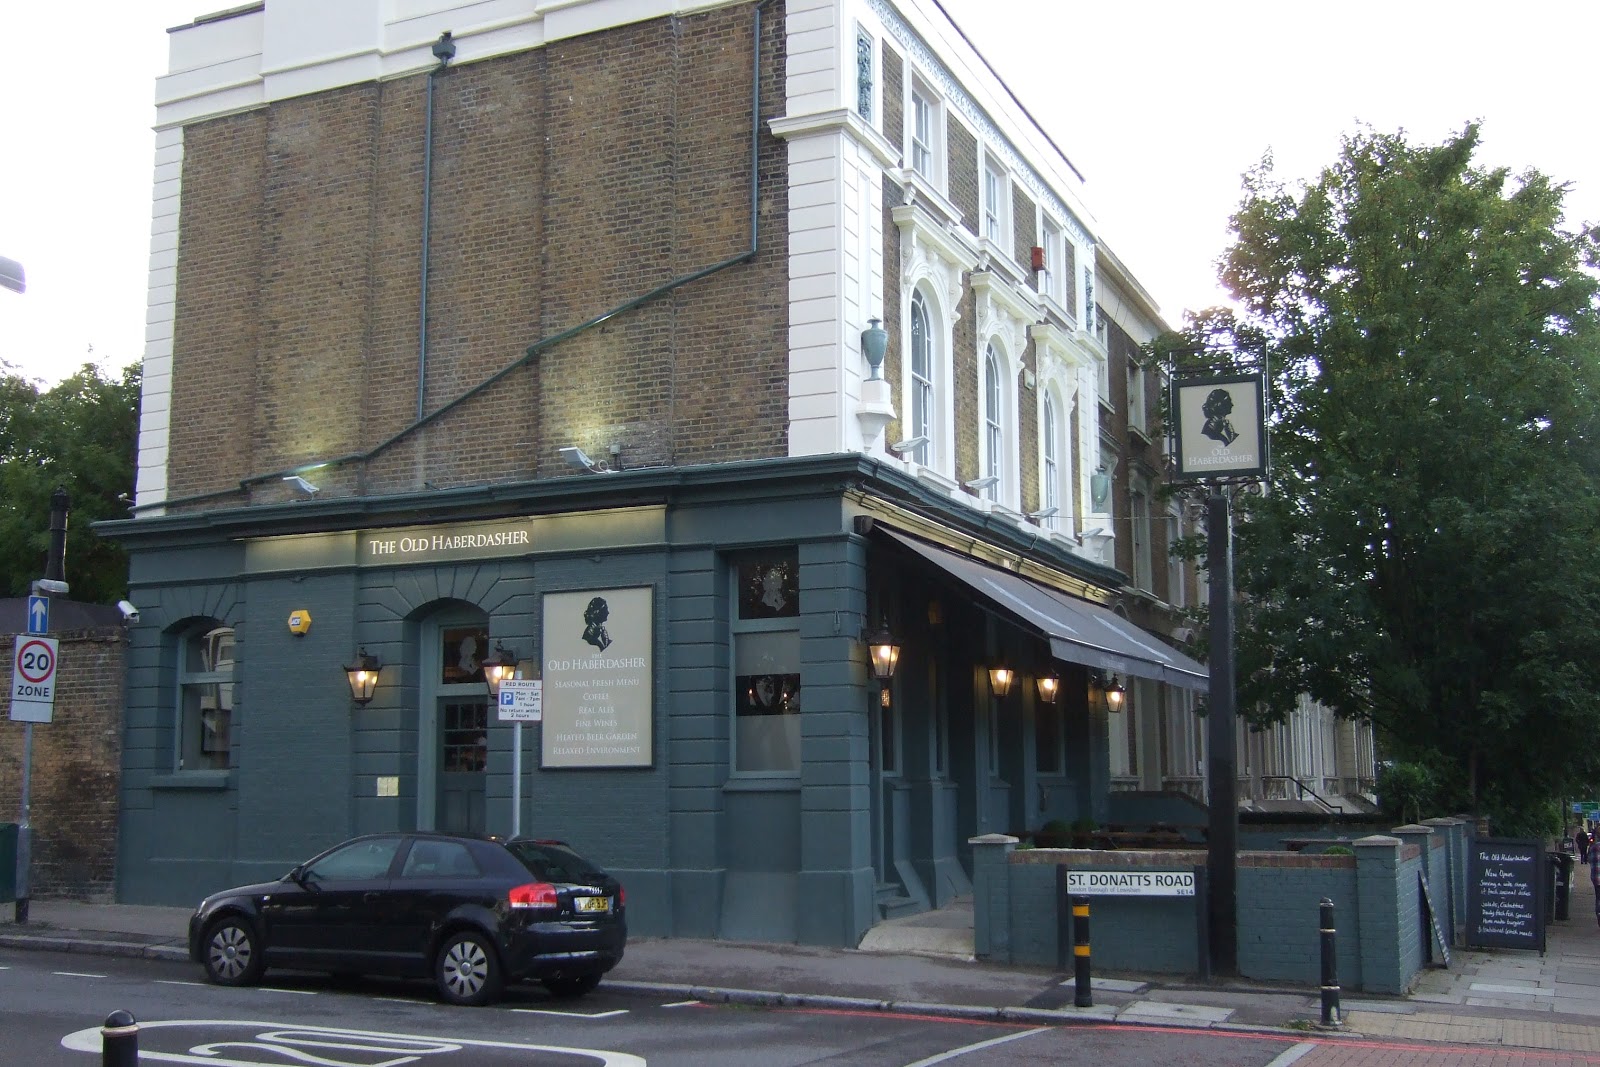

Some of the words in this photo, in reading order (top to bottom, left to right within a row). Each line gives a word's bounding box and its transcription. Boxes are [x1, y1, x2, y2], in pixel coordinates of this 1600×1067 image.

[1211, 448, 1230, 456] OLD
[1188, 454, 1253, 466] HABERDASHER
[370, 540, 396, 555] THE
[400, 537, 428, 553] OLD
[432, 531, 529, 550] HABERDASHER
[24, 652, 49, 671] 20
[548, 659, 570, 671] OLD
[572, 657, 646, 670] HABERDASHER
[555, 680, 590, 688] SEASONAL
[592, 679, 614, 687] FRESH
[616, 678, 640, 687] MENU
[17, 685, 50, 697] ZONE
[504, 693, 512, 705] P
[583, 693, 609, 701] COFFEE
[578, 706, 596, 714] REAL
[597, 706, 615, 714] ALES
[593, 719, 618, 727] WINES
[556, 733, 585, 741] HEATED
[586, 733, 604, 741] BEER
[605, 732, 637, 740] GARDEN
[553, 747, 584, 755] RELAXED
[586, 746, 640, 754] ENVIRONMENT
[1479, 852, 1489, 861] The
[1068, 874, 1086, 886] ST.
[1090, 874, 1151, 887] DONATTS
[1155, 875, 1193, 887] ROAD
